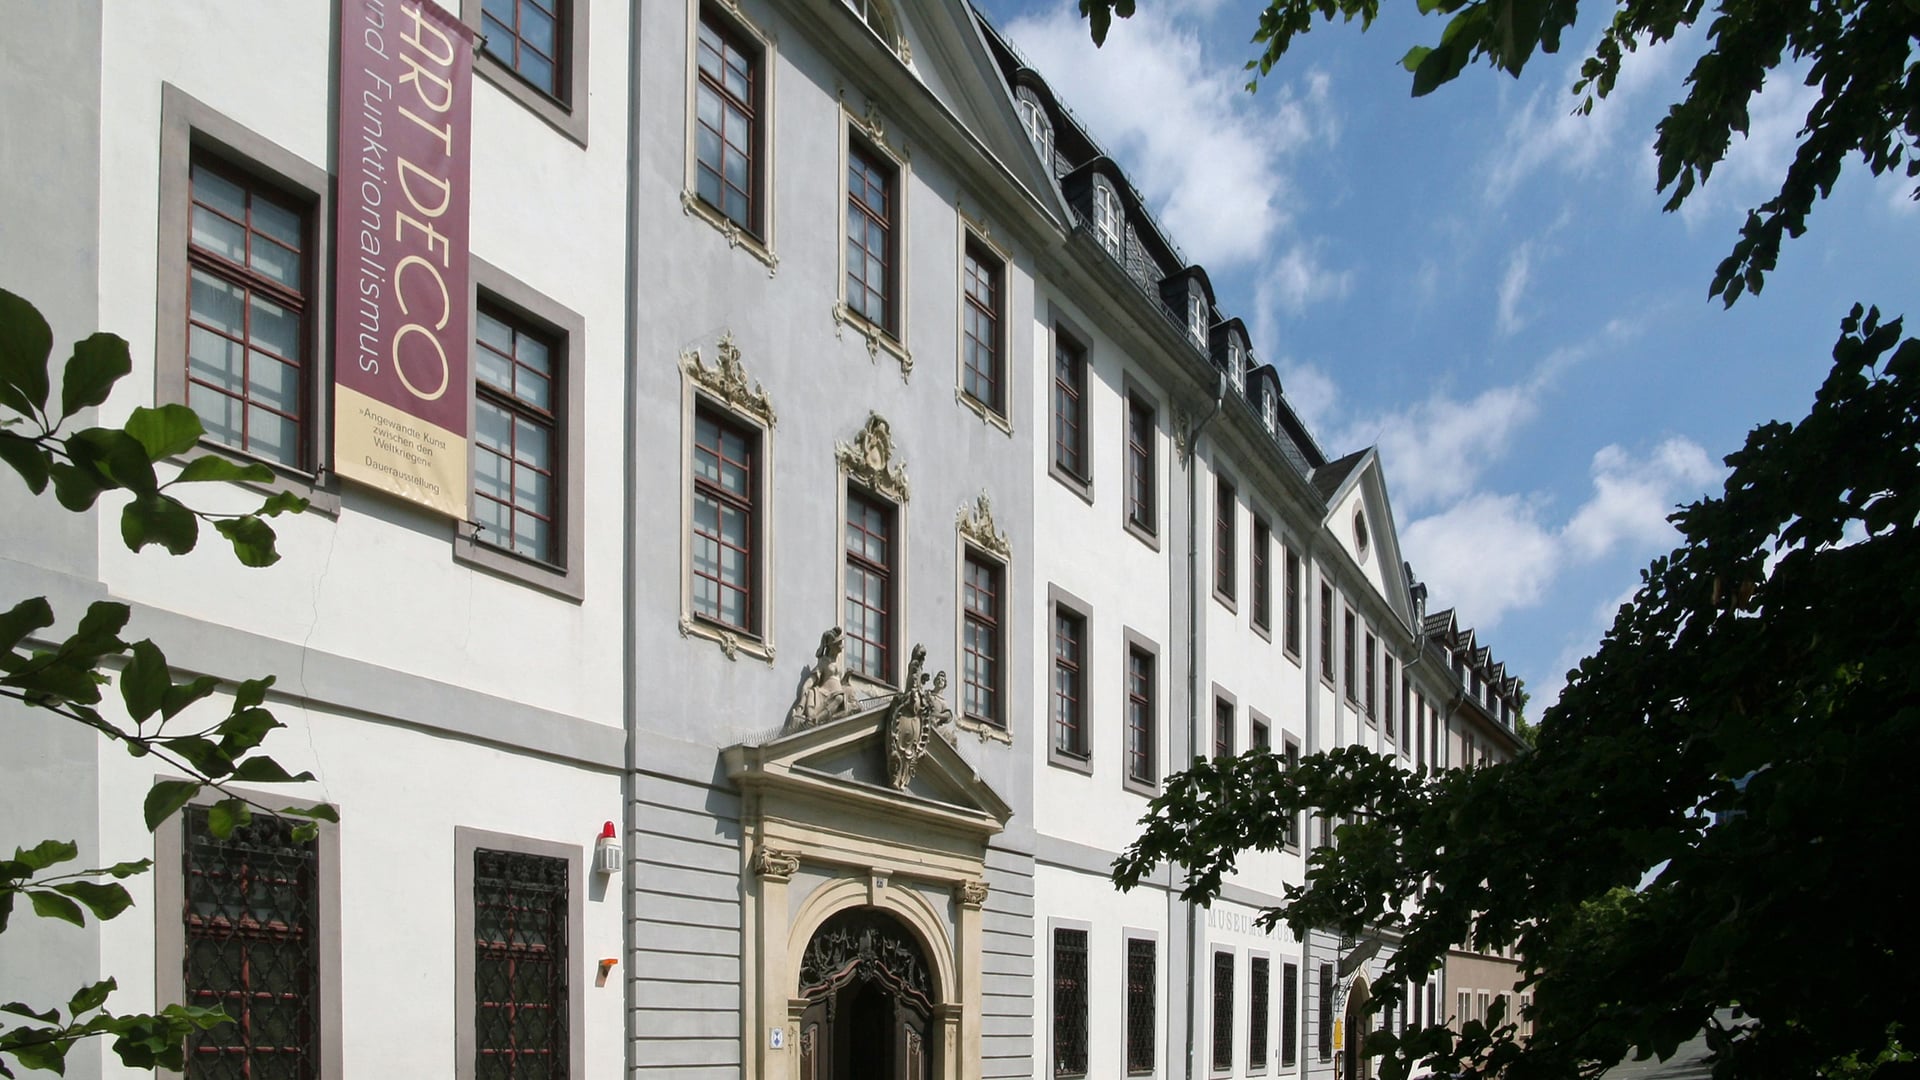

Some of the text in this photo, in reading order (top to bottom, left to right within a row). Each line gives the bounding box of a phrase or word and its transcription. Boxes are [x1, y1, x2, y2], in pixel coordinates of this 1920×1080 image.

[359, 0, 392, 375] nd Funktionalismus
[392, 2, 454, 401] ART DECO
[373, 426, 433, 456] zwischen den
[423, 432, 446, 450] Kunst
[365, 455, 440, 495] Dauerausstellung
